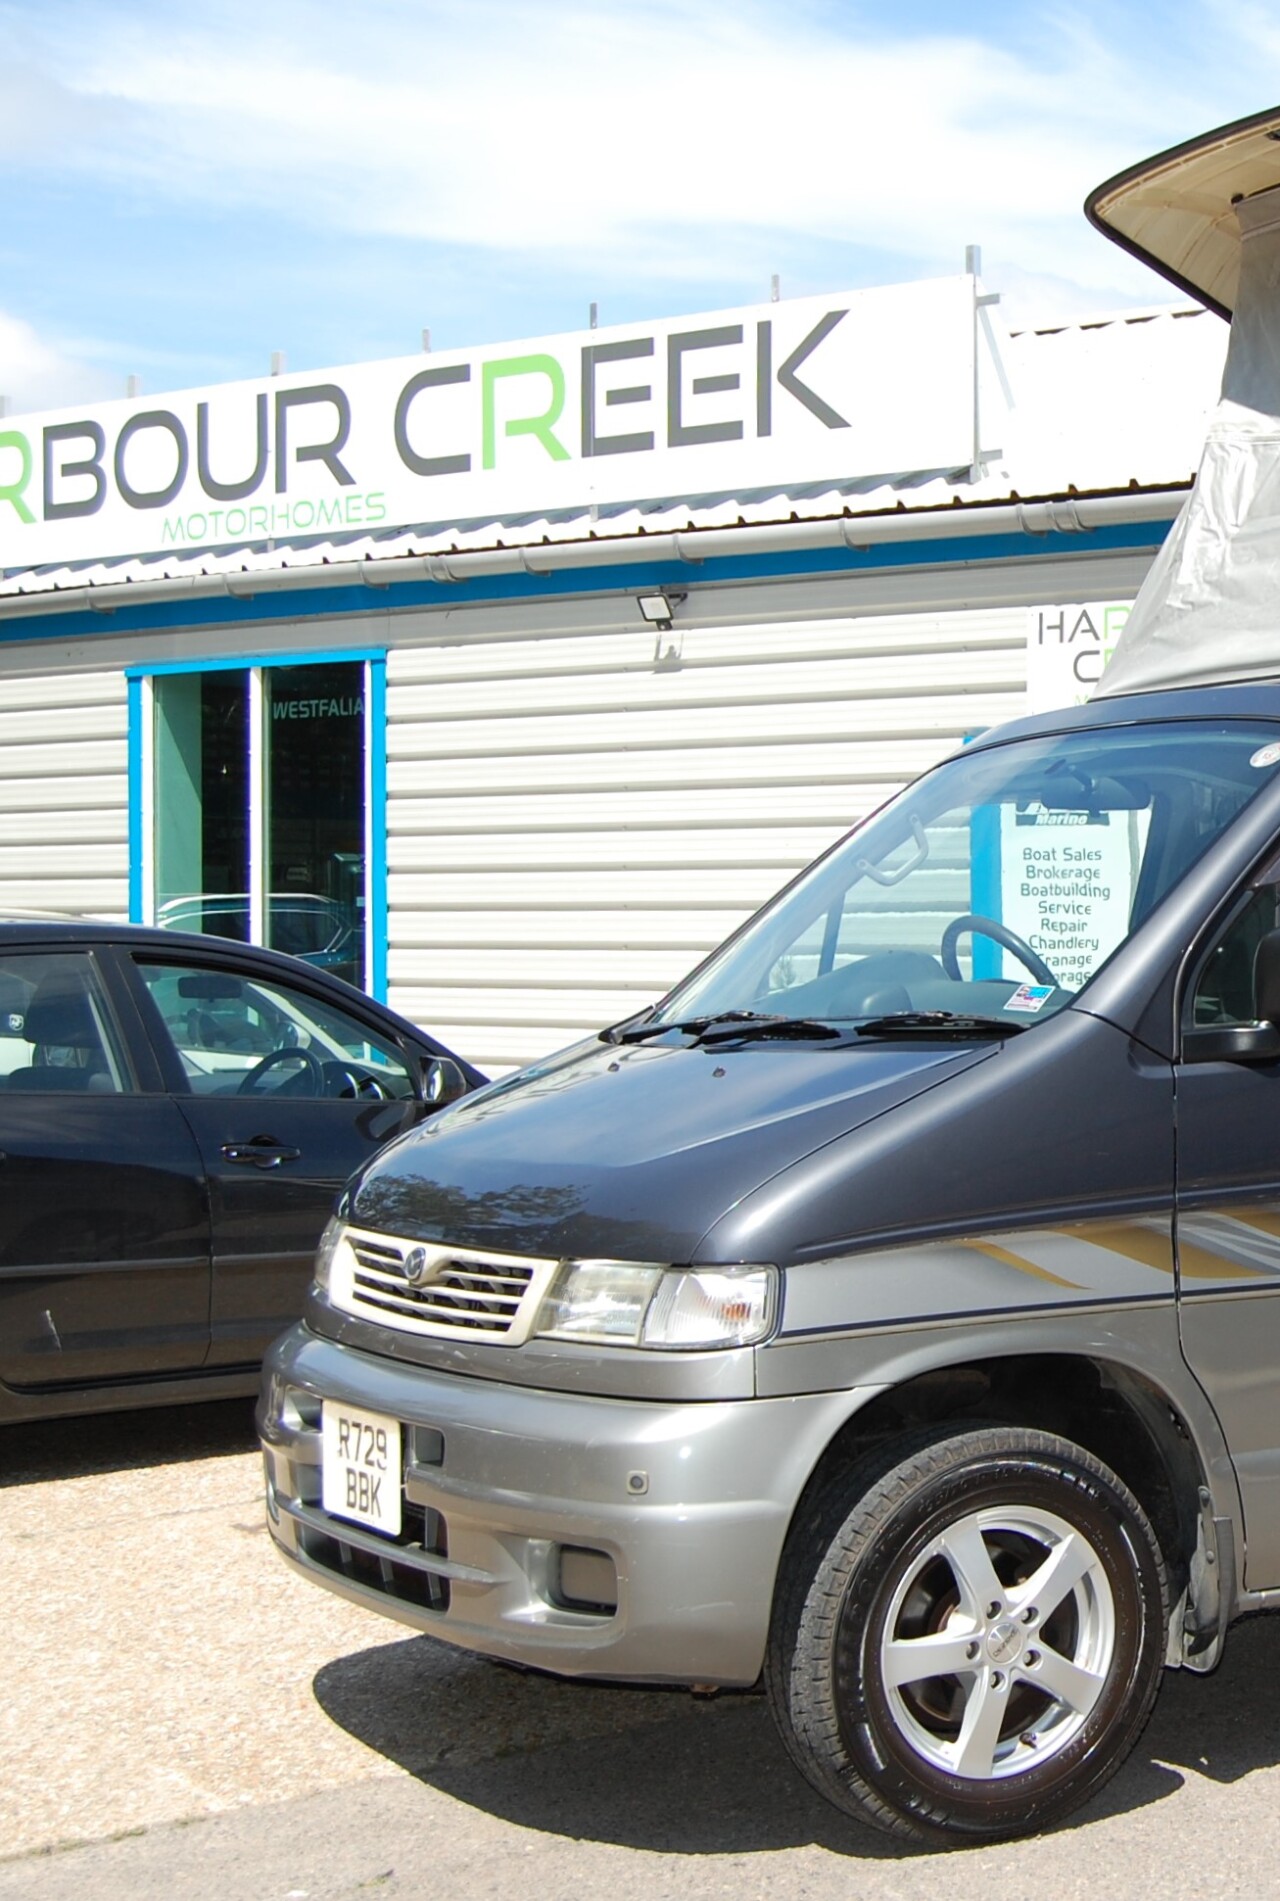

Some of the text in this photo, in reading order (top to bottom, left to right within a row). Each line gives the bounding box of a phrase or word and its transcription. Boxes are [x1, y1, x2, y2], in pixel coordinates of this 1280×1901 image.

[394, 308, 853, 477] CREEK
[161, 492, 387, 544] MOTORHOMES
[273, 697, 365, 719] WESTFALIA
[1022, 847, 1102, 861] Boat Sales
[1025, 865, 1101, 882] Brokerage
[1020, 882, 1111, 901] Boatbuilding
[1038, 900, 1092, 915] Service
[1041, 917, 1088, 935] Repair
[1028, 934, 1099, 951] Chandlery
[1037, 953, 1093, 968] ranage
[338, 1417, 388, 1471] R729
[346, 1467, 382, 1518] BBK
